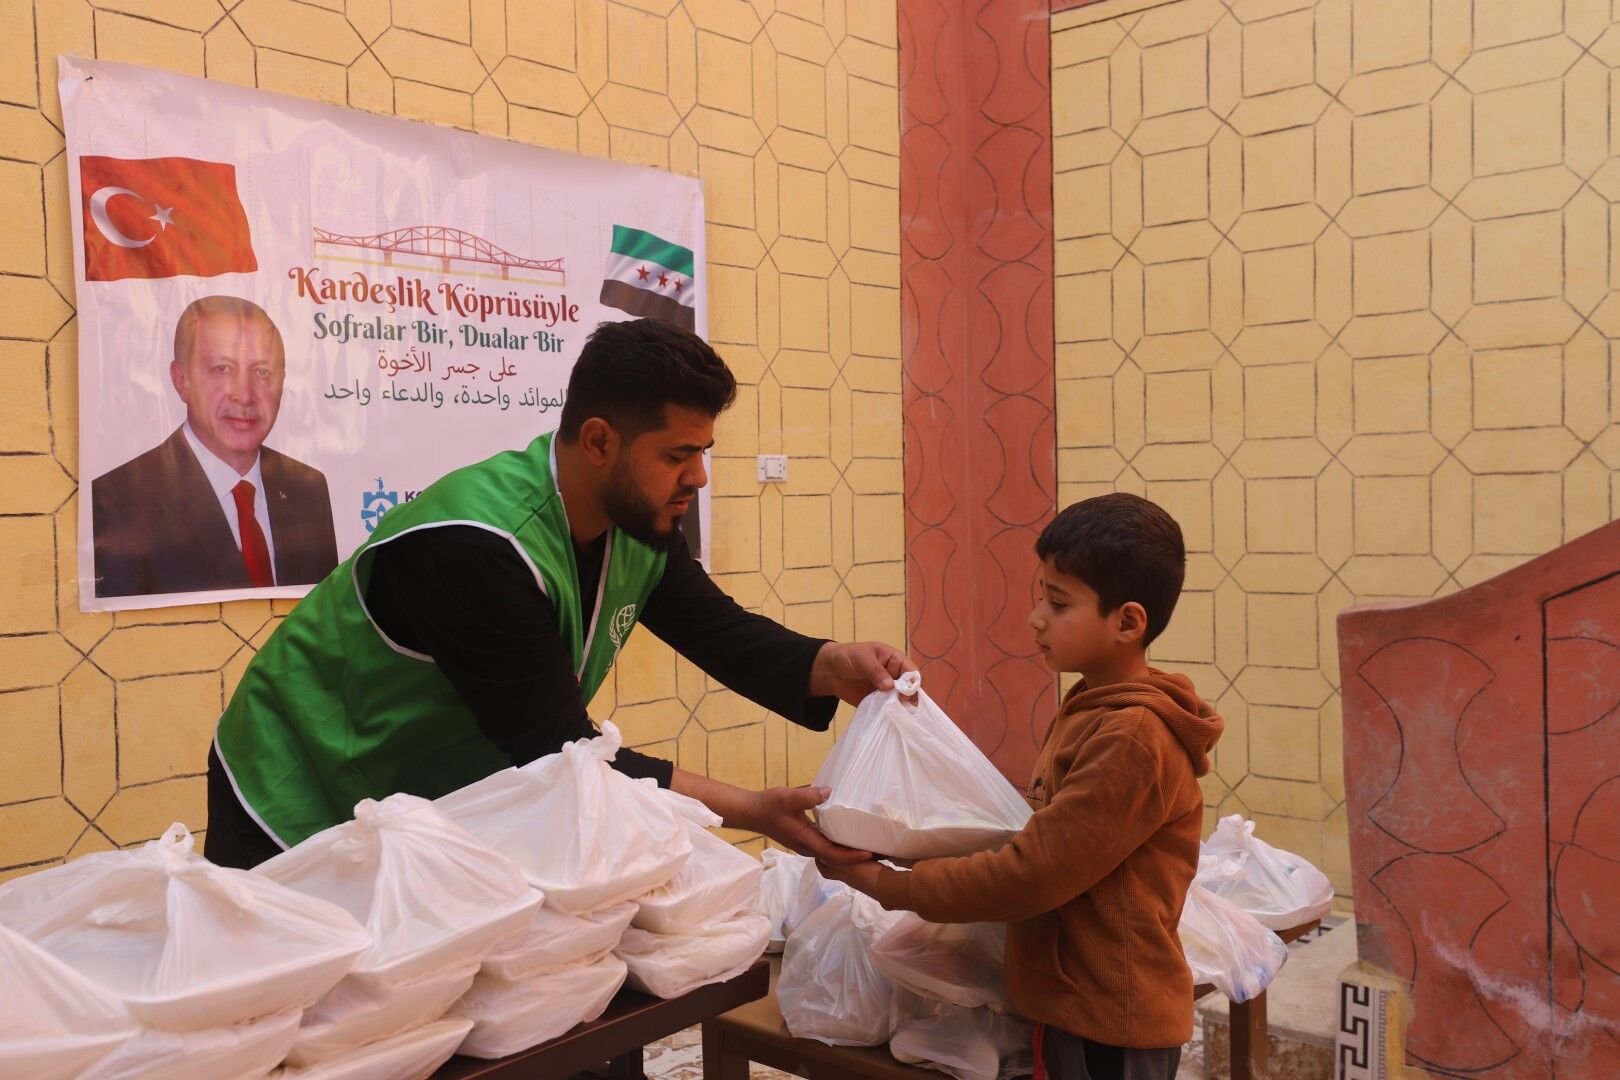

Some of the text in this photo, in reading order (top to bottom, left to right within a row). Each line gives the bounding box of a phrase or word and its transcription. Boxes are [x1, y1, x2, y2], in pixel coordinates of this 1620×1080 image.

[289, 266, 579, 327] Kardeşlik Köprüsüyle
[314, 312, 564, 353] Sofralar Bir, Dualar Bir
[378, 346, 517, 382] على جسر الأخوة
[324, 379, 371, 406] واحد
[382, 380, 444, 408] والدعاء
[454, 385, 510, 411] واحدة،
